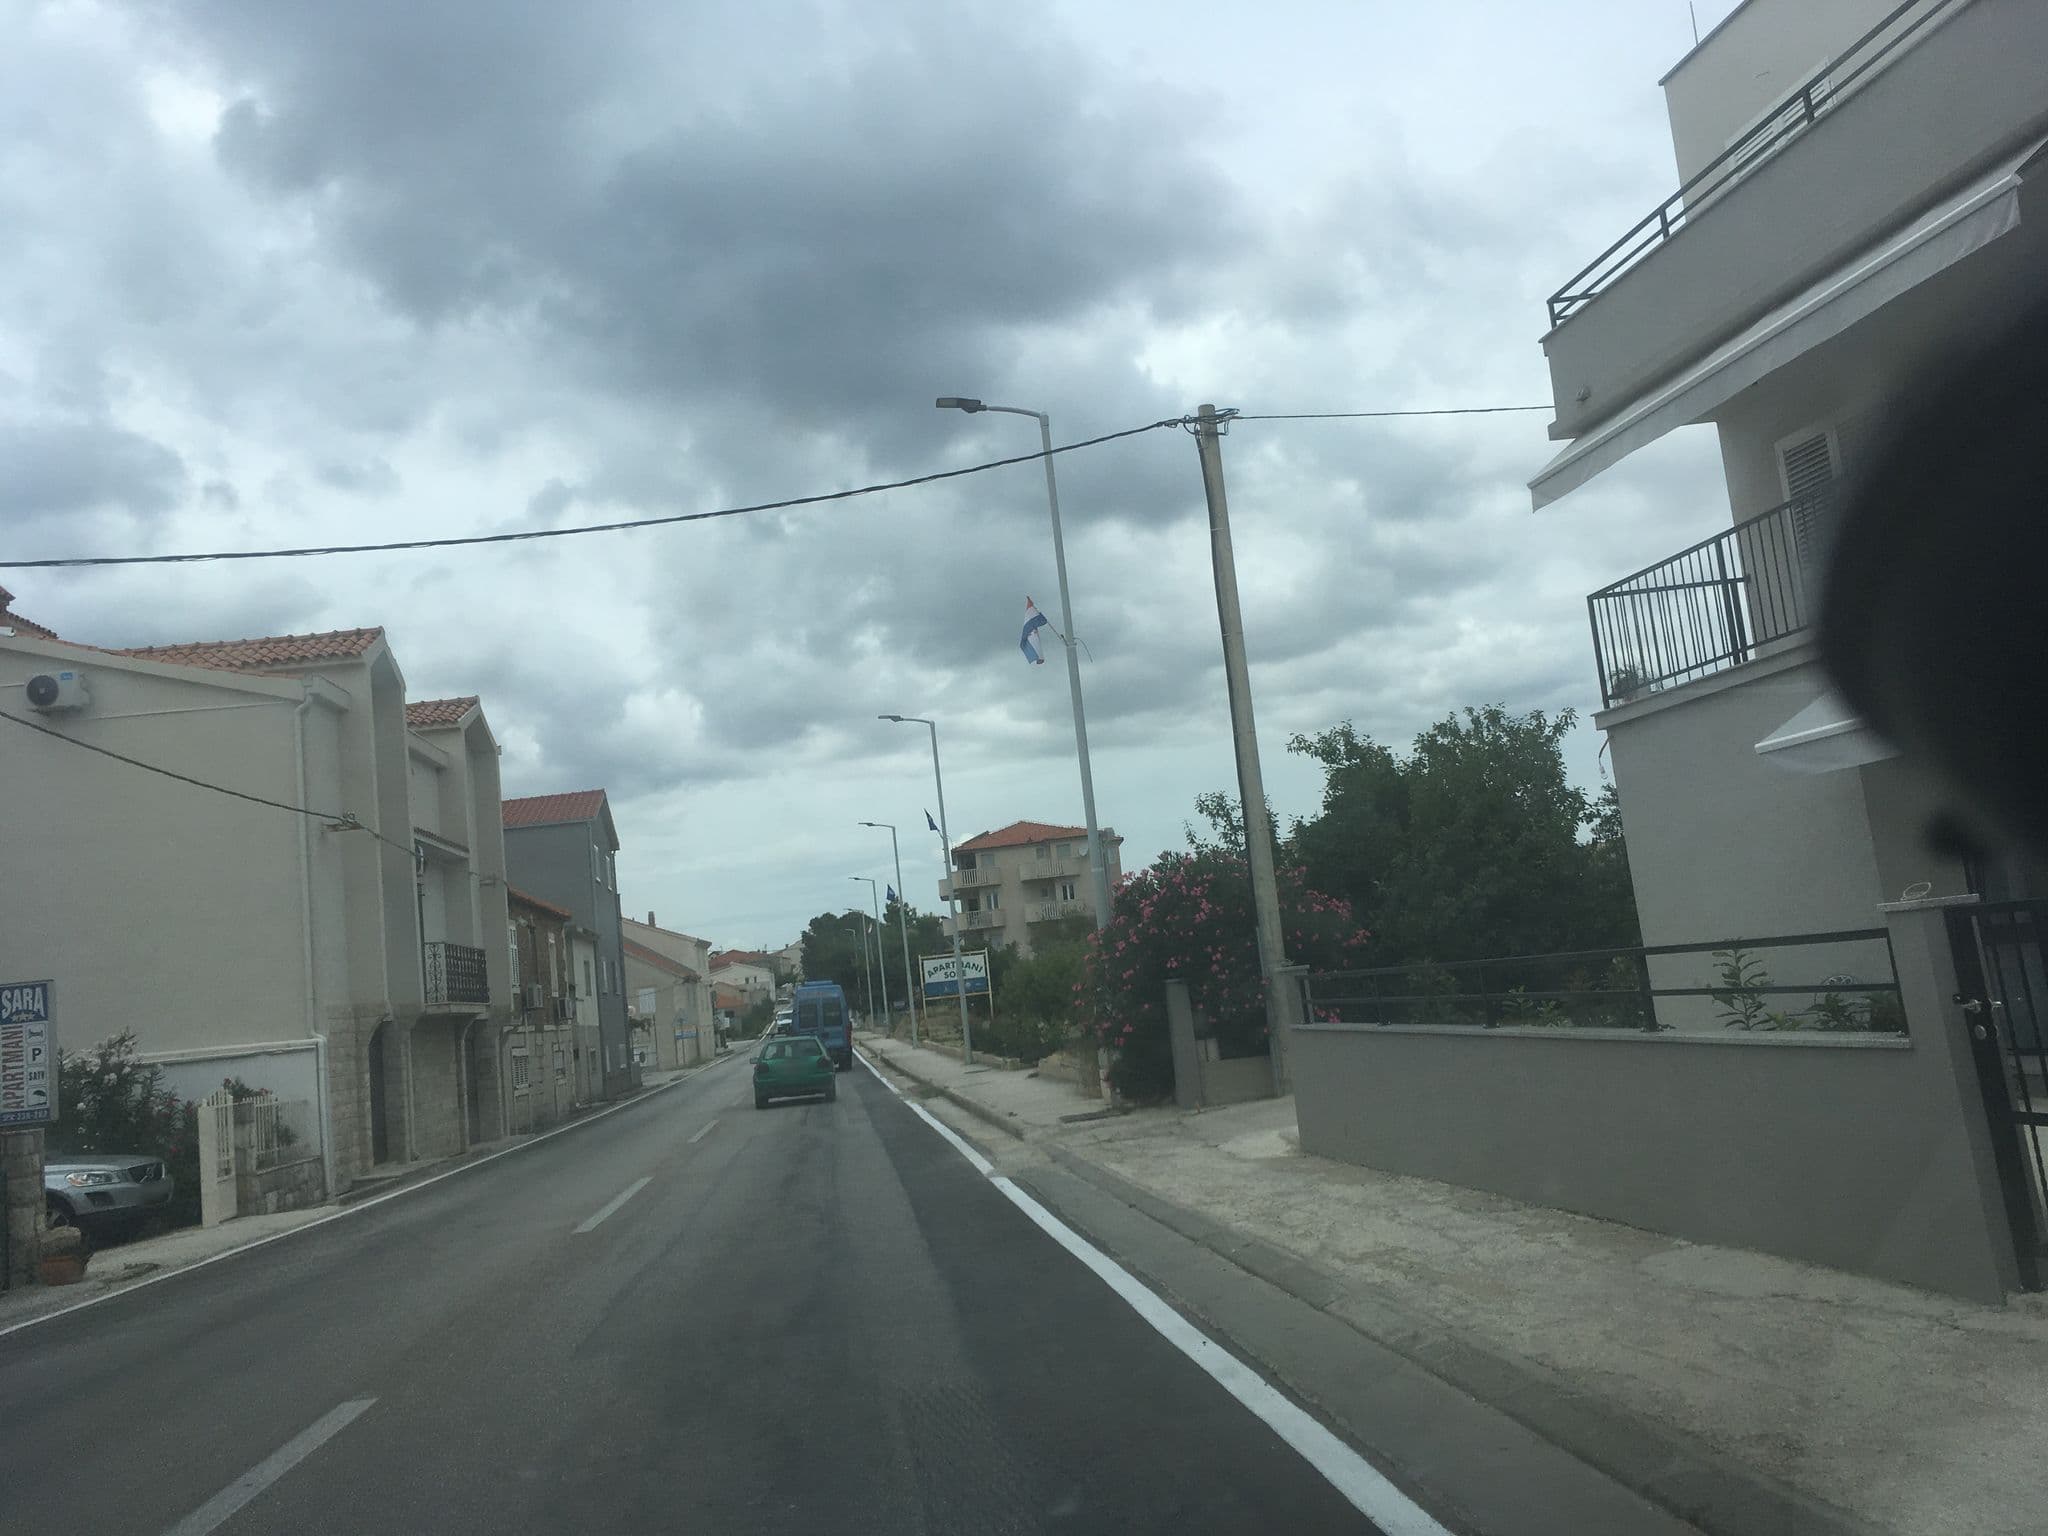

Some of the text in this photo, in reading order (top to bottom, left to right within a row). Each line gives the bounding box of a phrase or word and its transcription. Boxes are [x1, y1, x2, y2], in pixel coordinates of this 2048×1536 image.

[927, 961, 983, 978] APARTANI
[1, 987, 45, 1019] SARA
[32, 1048, 41, 1061] P
[2, 1025, 25, 1109] APARTMANI
